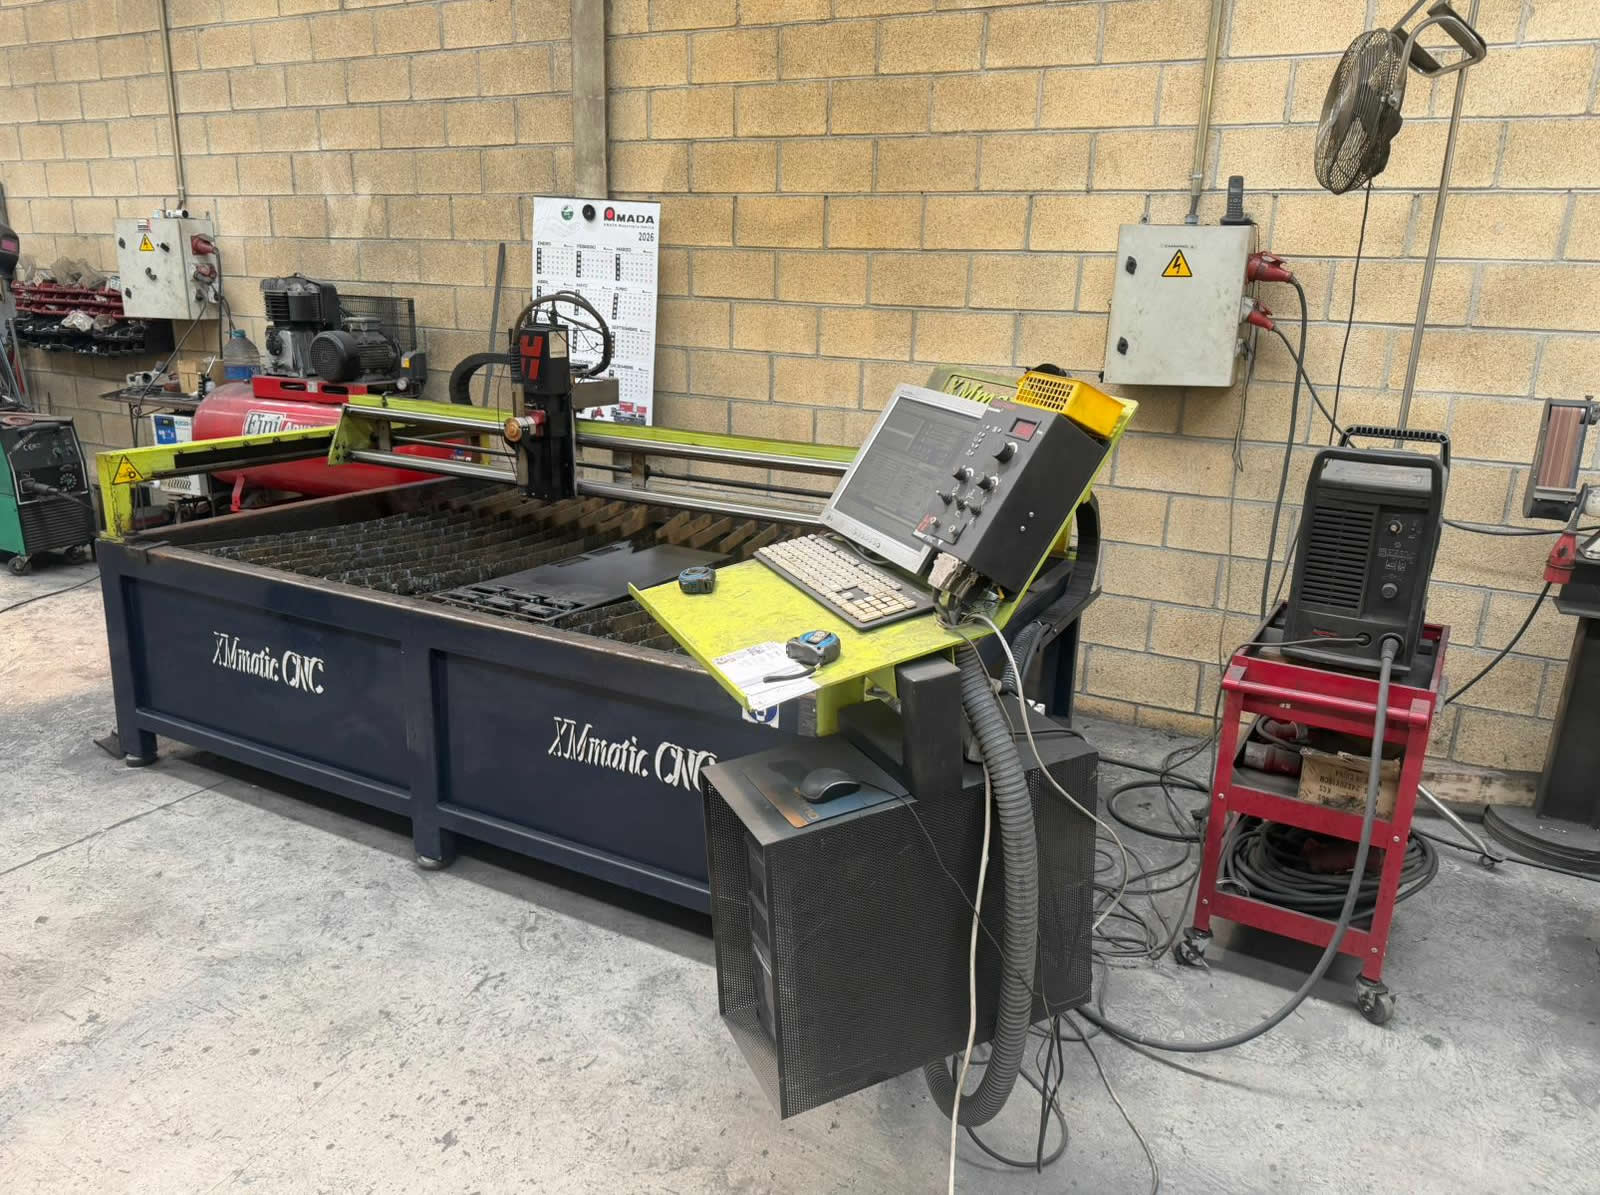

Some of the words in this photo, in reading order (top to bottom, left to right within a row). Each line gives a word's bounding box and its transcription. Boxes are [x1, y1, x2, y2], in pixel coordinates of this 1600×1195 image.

[604, 206, 654, 224] AMADA
[638, 232, 654, 242] 2026
[246, 413, 281, 434] Fini
